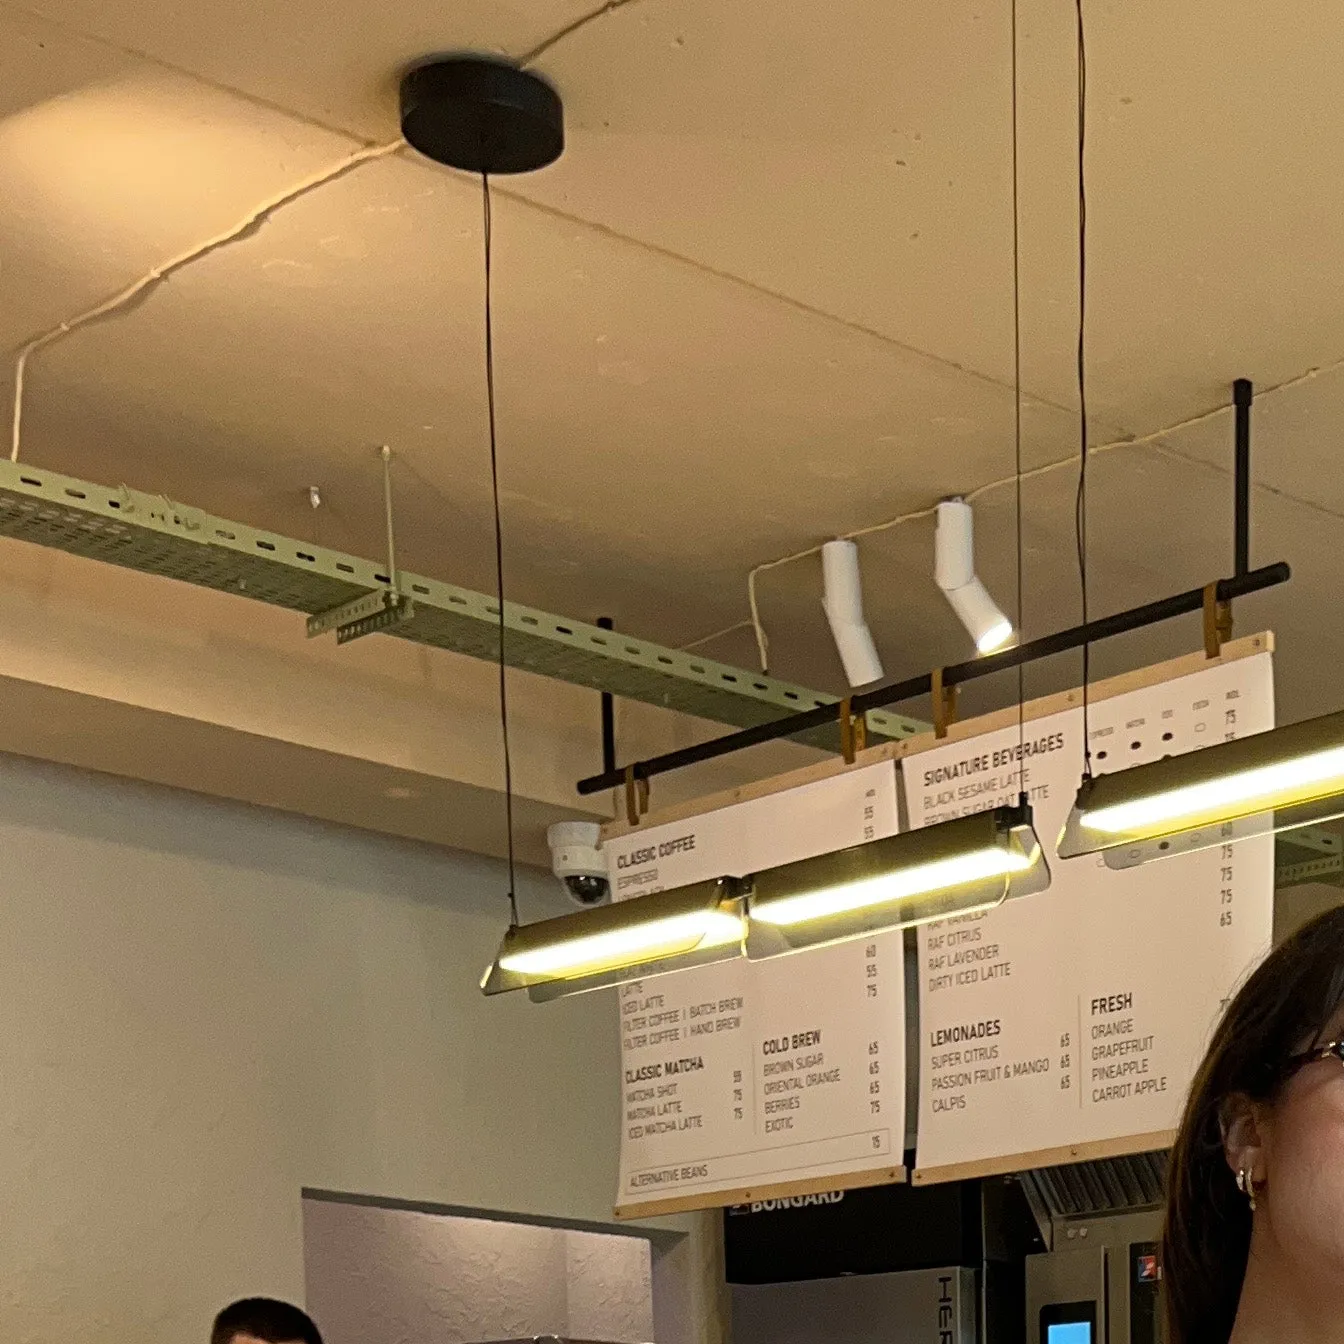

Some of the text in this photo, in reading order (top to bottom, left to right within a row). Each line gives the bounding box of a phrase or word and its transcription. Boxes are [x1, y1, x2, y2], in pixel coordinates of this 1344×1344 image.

[924, 732, 1064, 787] SIGNATURE BEVERAGES
[924, 791, 956, 811] BLACK
[957, 777, 998, 801] SESAME
[1000, 768, 1031, 791] LATTE
[617, 834, 696, 870] CLASSIC COFFEE
[928, 866, 1233, 951] RAF CITRUS 75
[928, 888, 1232, 971] RAF LAVENDER 75
[928, 911, 1232, 992] DIRTY ICED LATTE 65
[640, 995, 665, 1012] LATTE
[649, 1009, 680, 1027] COFFEE
[719, 996, 744, 1014] BREW
[1091, 992, 1133, 1016] FRESH
[650, 1028, 680, 1045] COFFEE
[716, 1015, 741, 1032] BREW
[763, 1029, 822, 1056] COLD BREW
[930, 1018, 1002, 1048] LEMONADES
[1091, 1018, 1134, 1040] ORANGE
[763, 1041, 879, 1077] BROWN SUGAR 65
[931, 1033, 1070, 1070] SUPER CITRUS 65
[1091, 1035, 1154, 1061] GRAPEFRUIT
[626, 1056, 705, 1084] CLASSIC MATCHA
[764, 1077, 804, 1095] ORIENTAL
[806, 1068, 840, 1088] ORANGE
[932, 1053, 1070, 1092] PASSION FRUIT & MANGO 65
[1092, 1058, 1149, 1082] PINEAPPLE
[657, 1082, 678, 1099] SHOT
[932, 1074, 1070, 1113] CALPIS 65
[1092, 1076, 1168, 1103] CARROT APPLE
[657, 1100, 683, 1116] LATTE
[764, 1096, 800, 1115] BERRIES
[765, 1100, 880, 1133] EXOTIC 75
[644, 1120, 677, 1137] MATCHA
[678, 1115, 703, 1131] LATTE
[630, 1170, 680, 1188] ALTERNATIVE
[681, 1163, 709, 1180] BEANS
